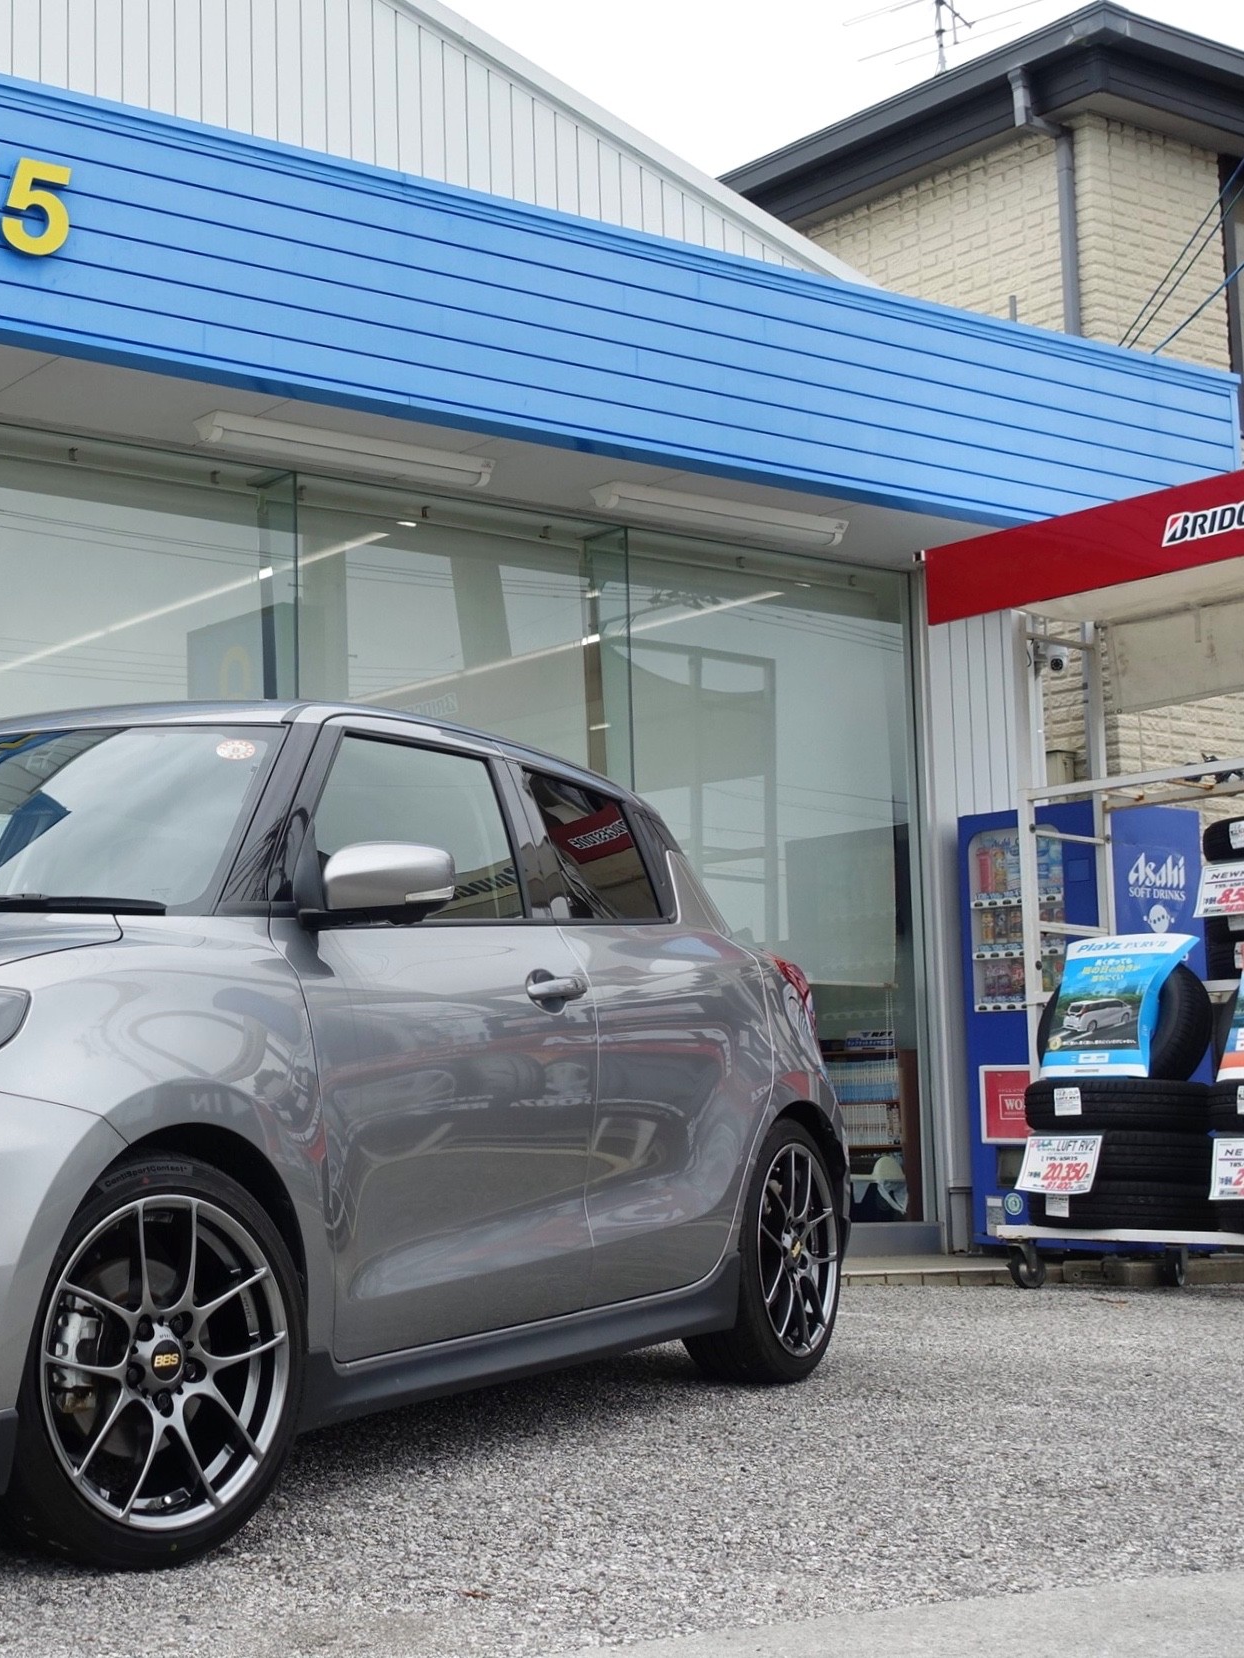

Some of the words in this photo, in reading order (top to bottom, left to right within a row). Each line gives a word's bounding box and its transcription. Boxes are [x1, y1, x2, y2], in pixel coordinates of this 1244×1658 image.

[1128, 853, 1185, 889] Asahi
[1129, 887, 1151, 899] SOFT
[1153, 888, 1186, 901] DRINKS
[1004, 1098, 1026, 1111] WO
[154, 1353, 179, 1367] BBS
